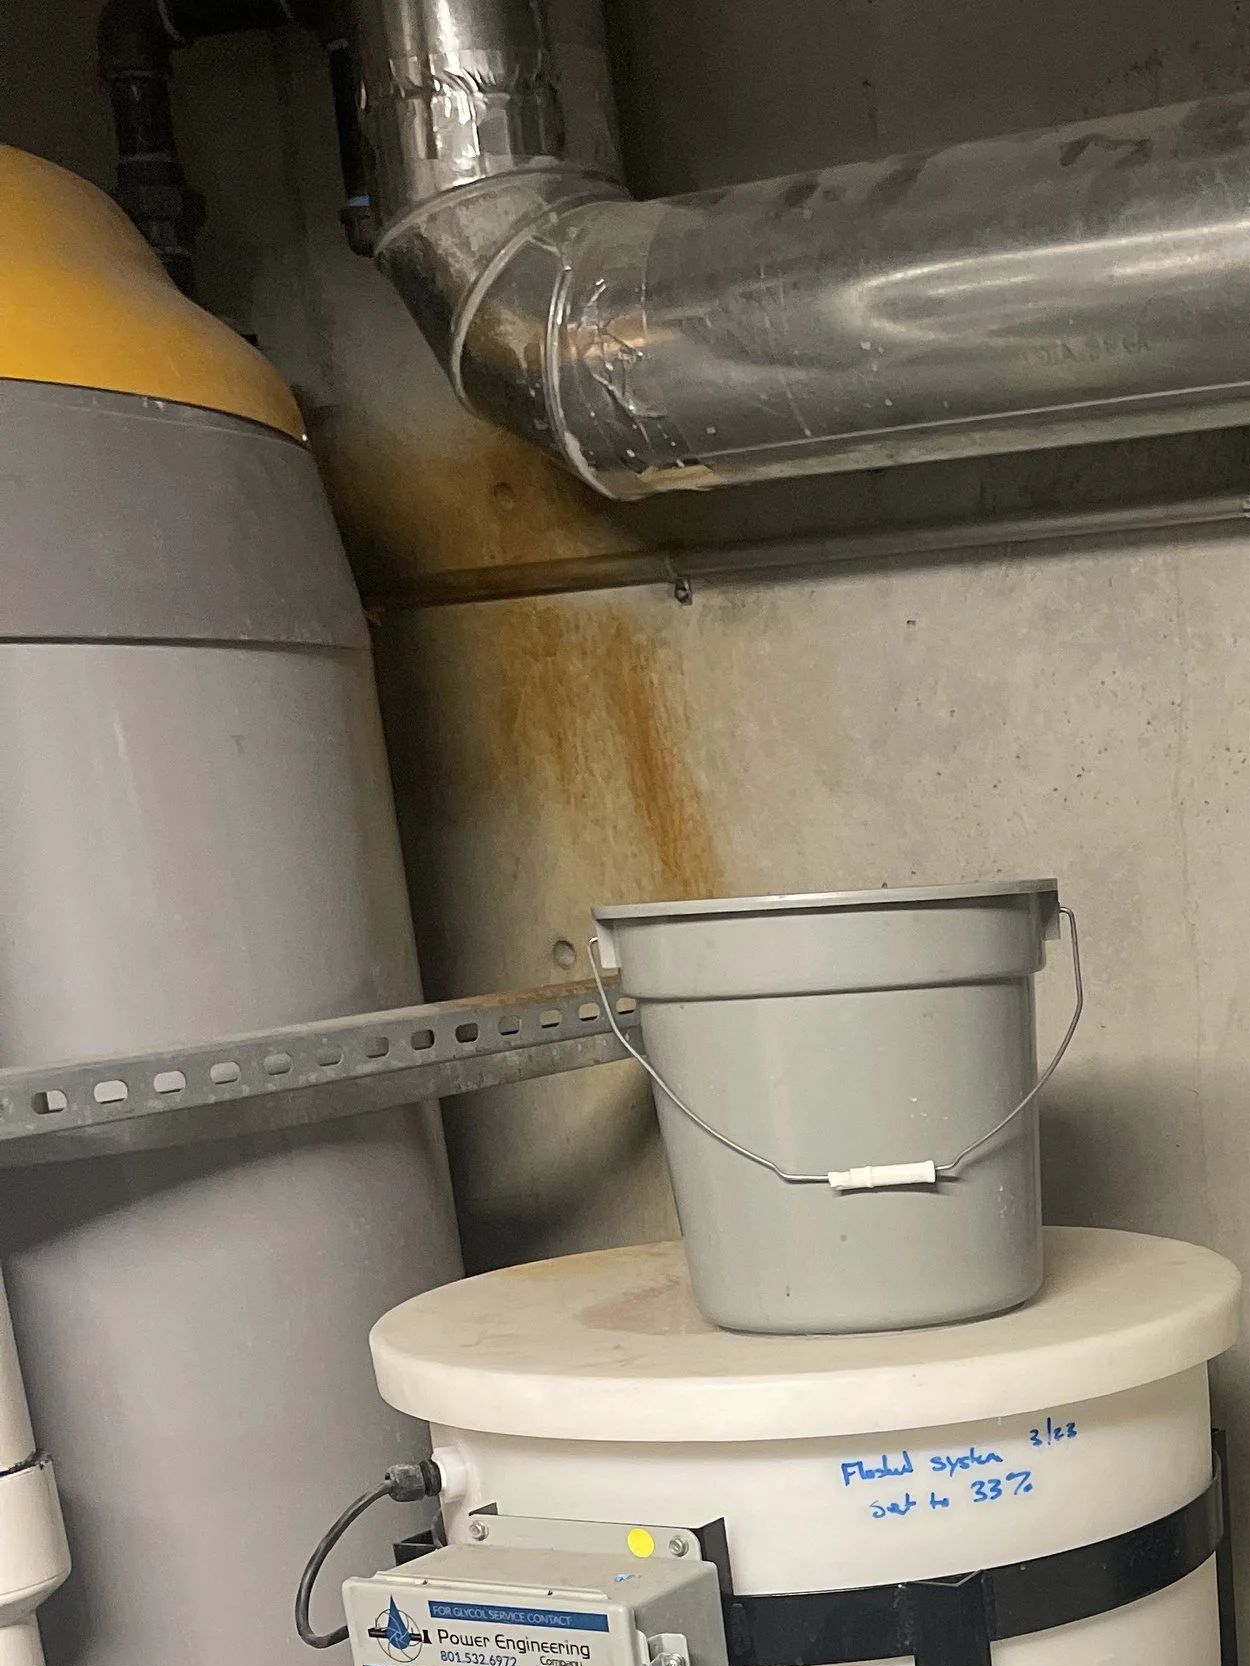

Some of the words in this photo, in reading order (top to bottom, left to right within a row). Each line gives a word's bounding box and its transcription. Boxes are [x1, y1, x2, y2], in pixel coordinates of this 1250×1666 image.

[1029, 1417, 1078, 1446] 3/23
[930, 1492, 950, 1509] to
[970, 1471, 1033, 1502] 33%
[433, 1605, 450, 1616] FOR
[453, 1606, 488, 1619] GLYCOL
[489, 1609, 524, 1622] SERVICE
[527, 1612, 571, 1626] CONTACT
[438, 1629, 490, 1648] Power
[495, 1633, 591, 1660] Engineering
